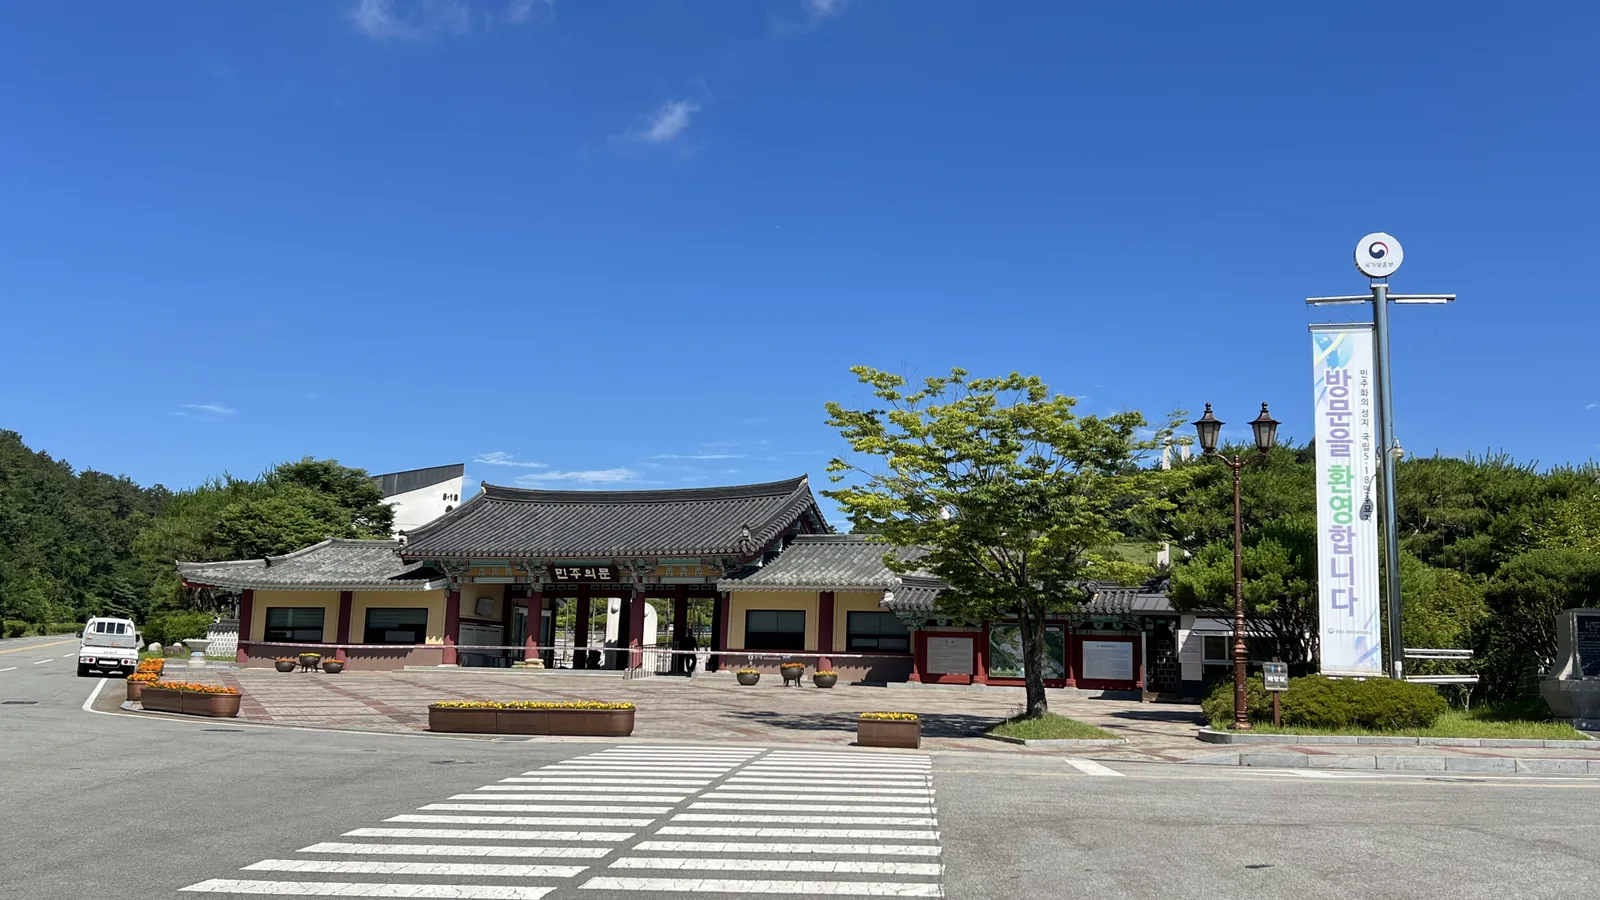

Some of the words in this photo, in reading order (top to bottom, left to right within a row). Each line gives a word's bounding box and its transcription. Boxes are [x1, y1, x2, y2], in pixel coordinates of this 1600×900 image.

[1325, 369, 1354, 458] 방문을
[554, 567, 611, 580] 민주의문
[1327, 464, 1358, 617] 환영합니다
